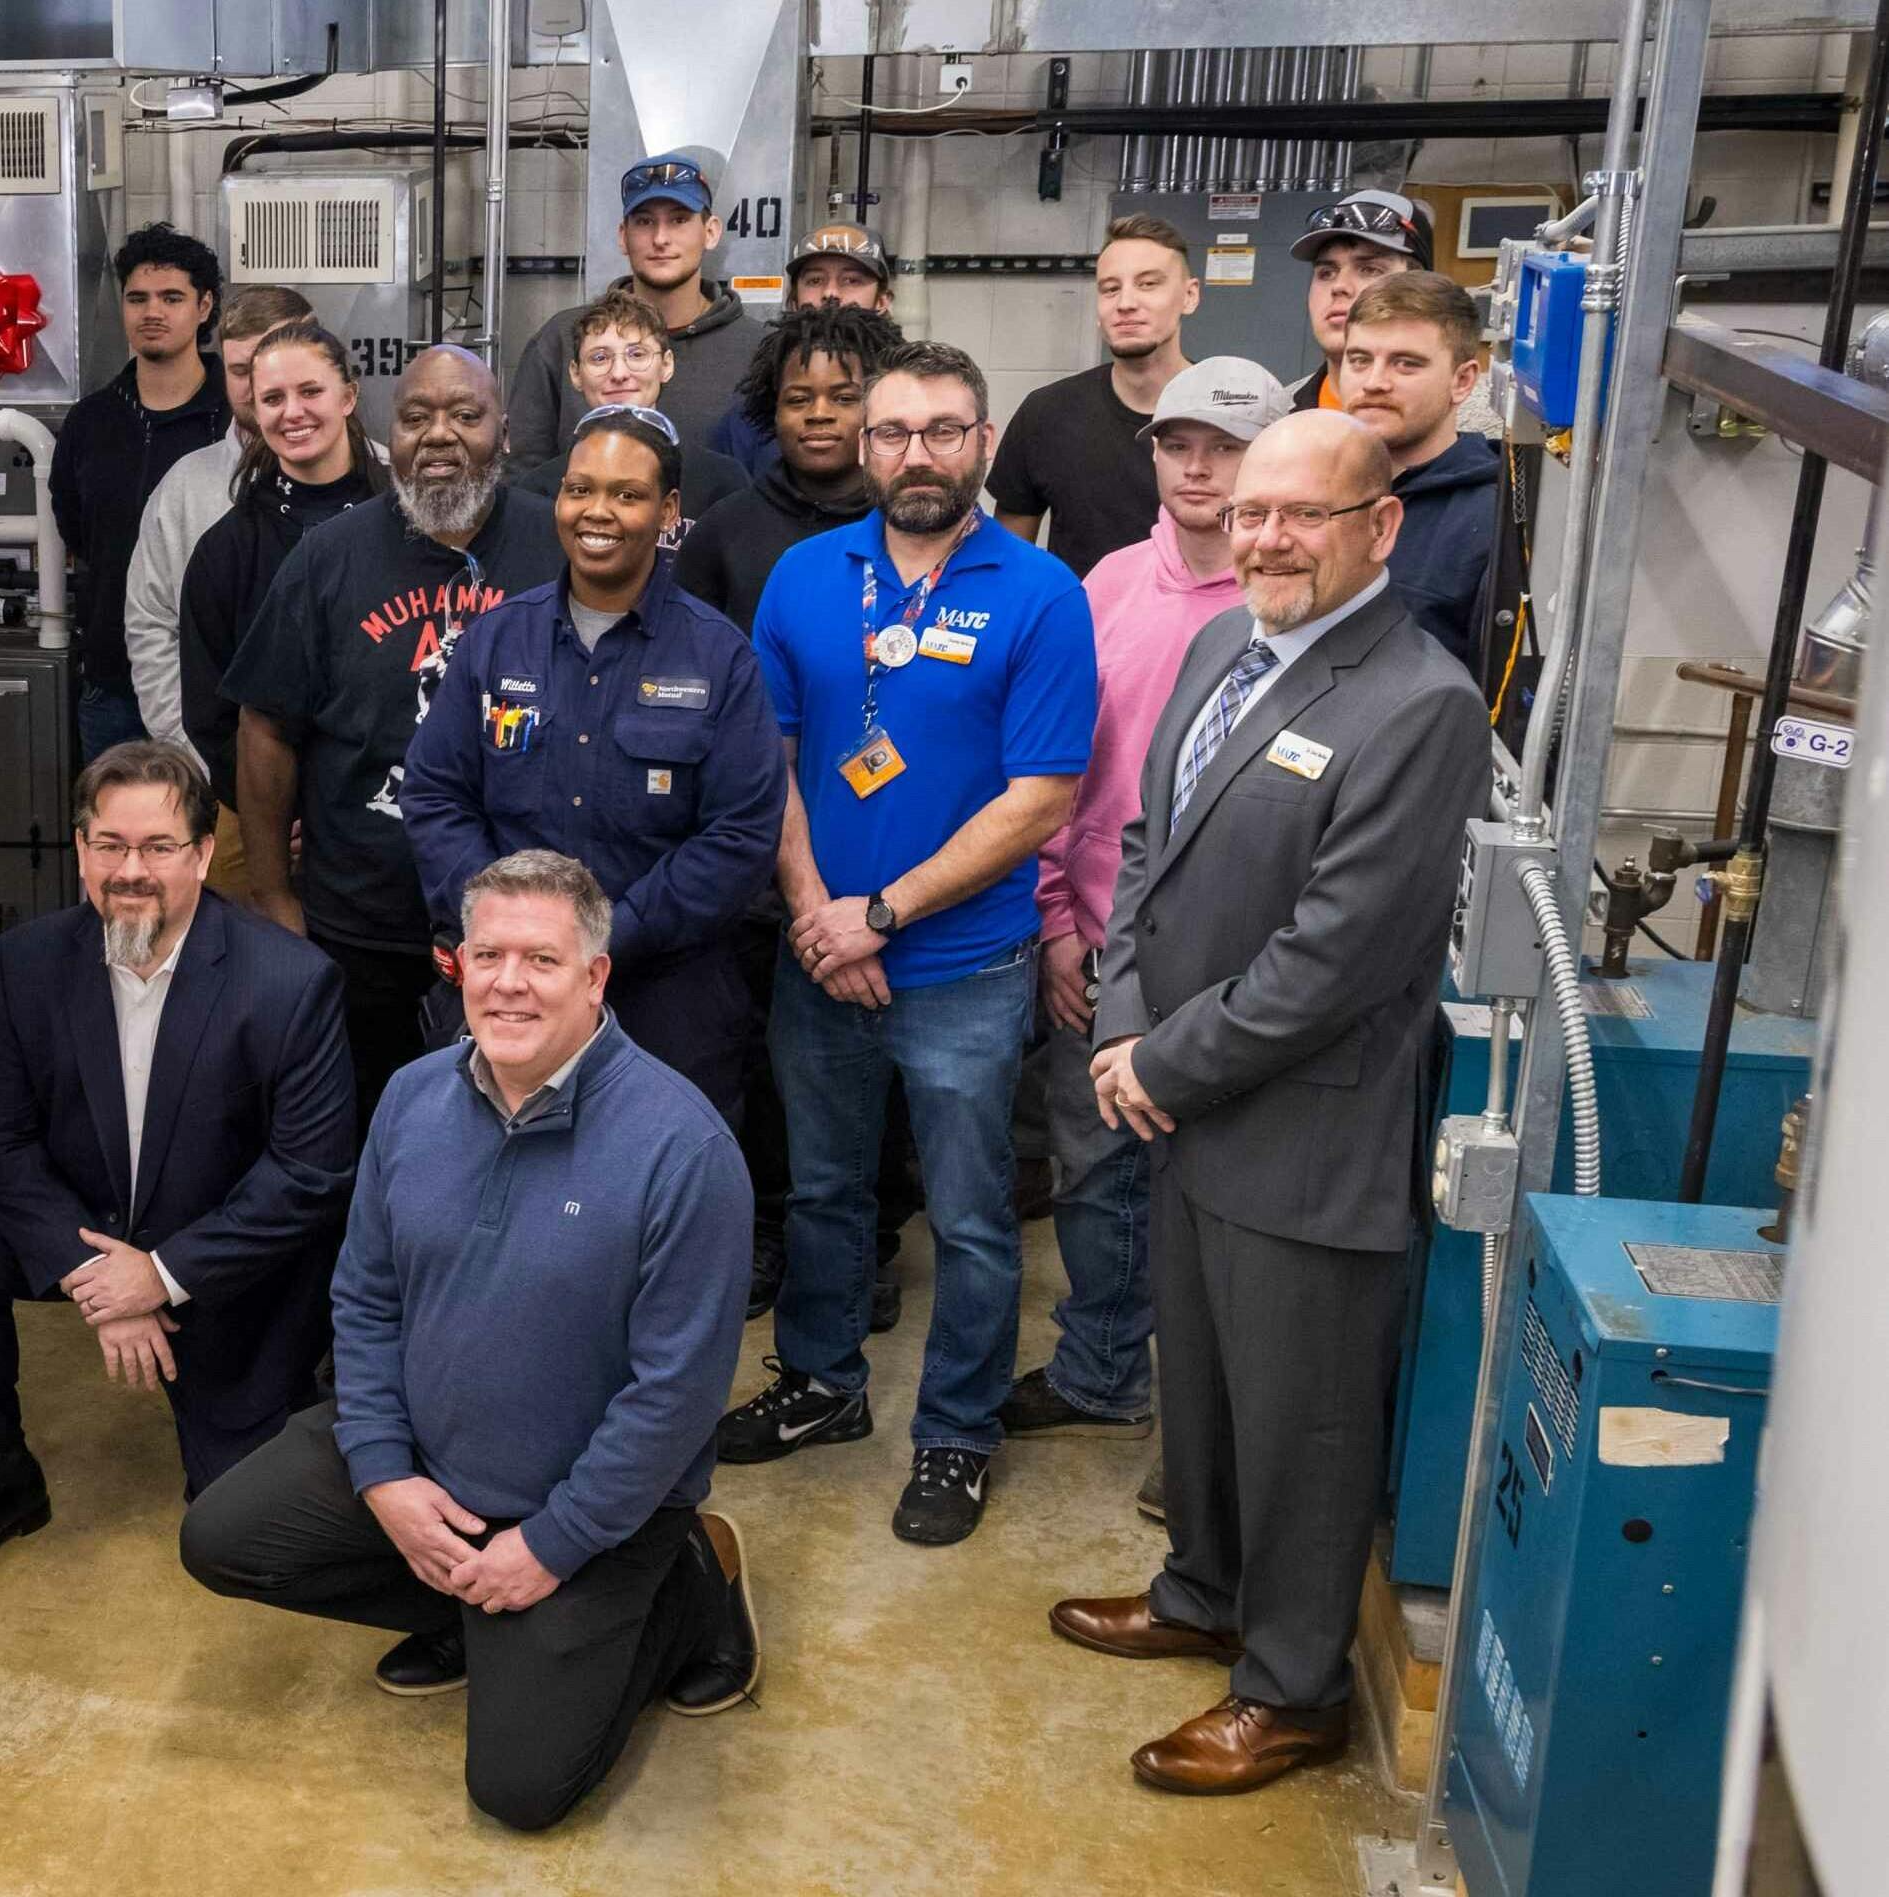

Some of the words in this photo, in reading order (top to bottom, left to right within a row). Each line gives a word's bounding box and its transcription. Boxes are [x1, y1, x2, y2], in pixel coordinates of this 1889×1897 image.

[727, 197, 781, 238] 40
[352, 338, 402, 376] 39
[360, 584, 505, 644] MUHAMM
[935, 606, 990, 630] MATC
[1810, 734, 1849, 756] G-2
[1496, 1439, 1526, 1549] 25
